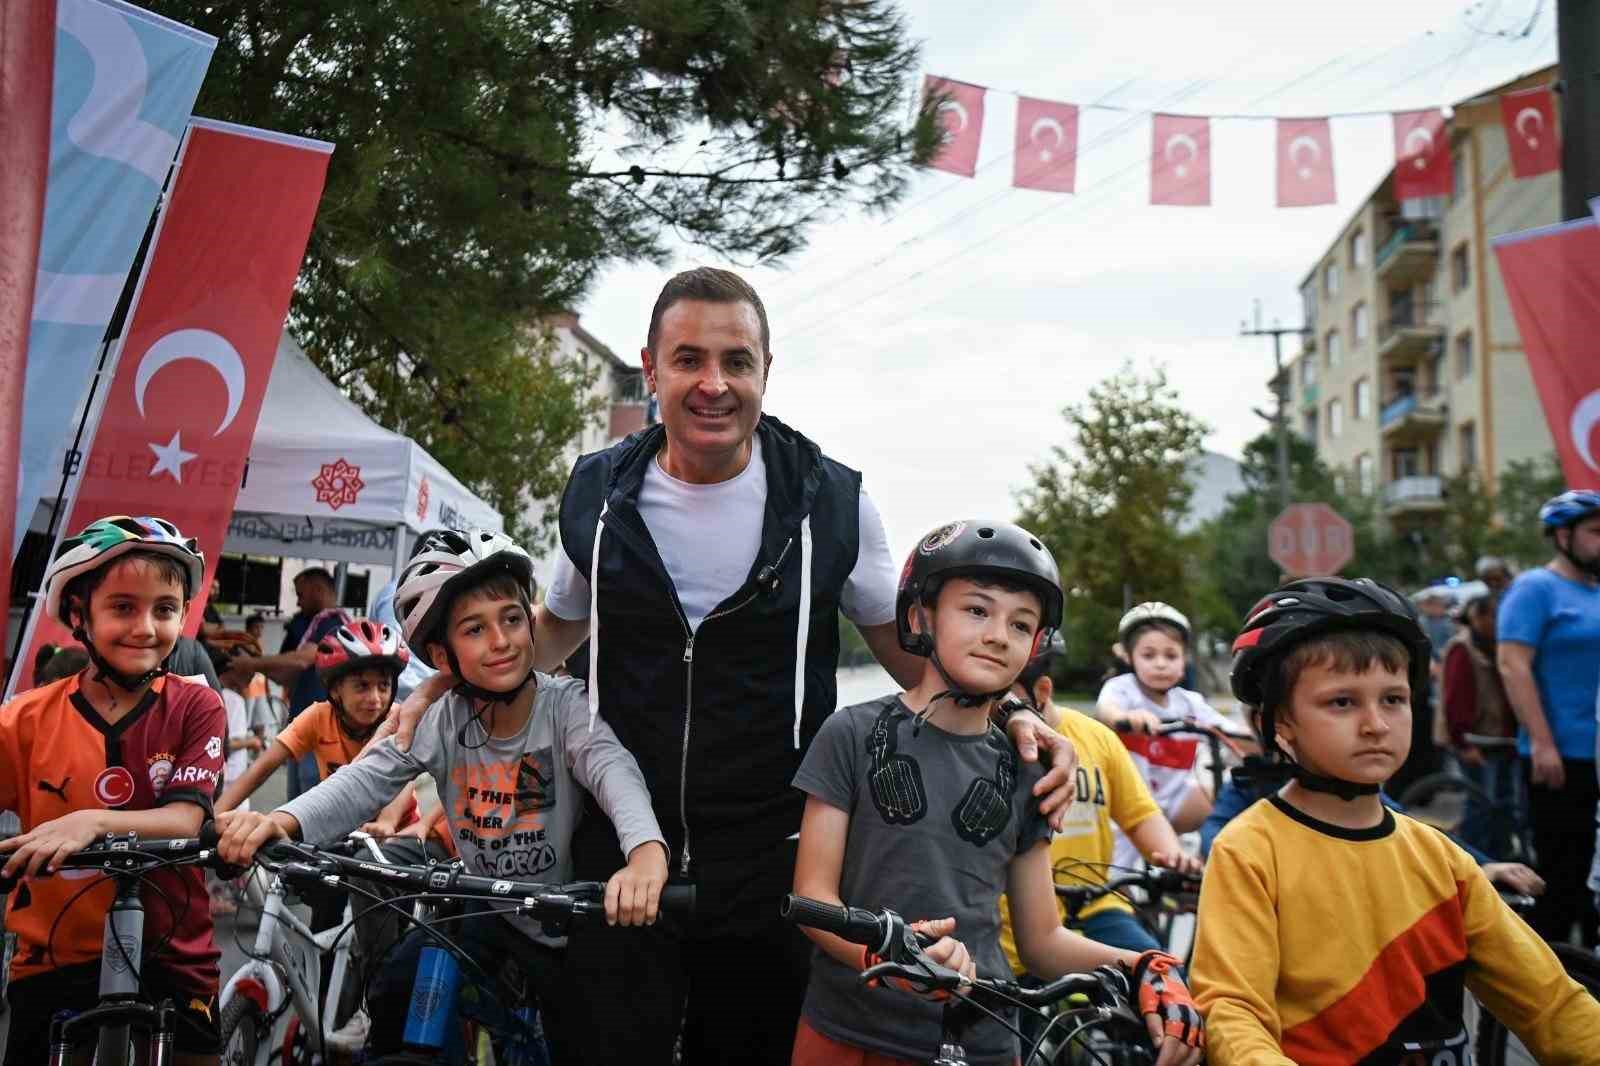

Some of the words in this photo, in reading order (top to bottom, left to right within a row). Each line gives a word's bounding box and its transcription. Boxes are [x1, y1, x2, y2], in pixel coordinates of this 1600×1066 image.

[481, 790, 513, 805] THE
[491, 836, 511, 850] OF
[514, 830, 545, 845] THE
[475, 843, 556, 877] WORLD
